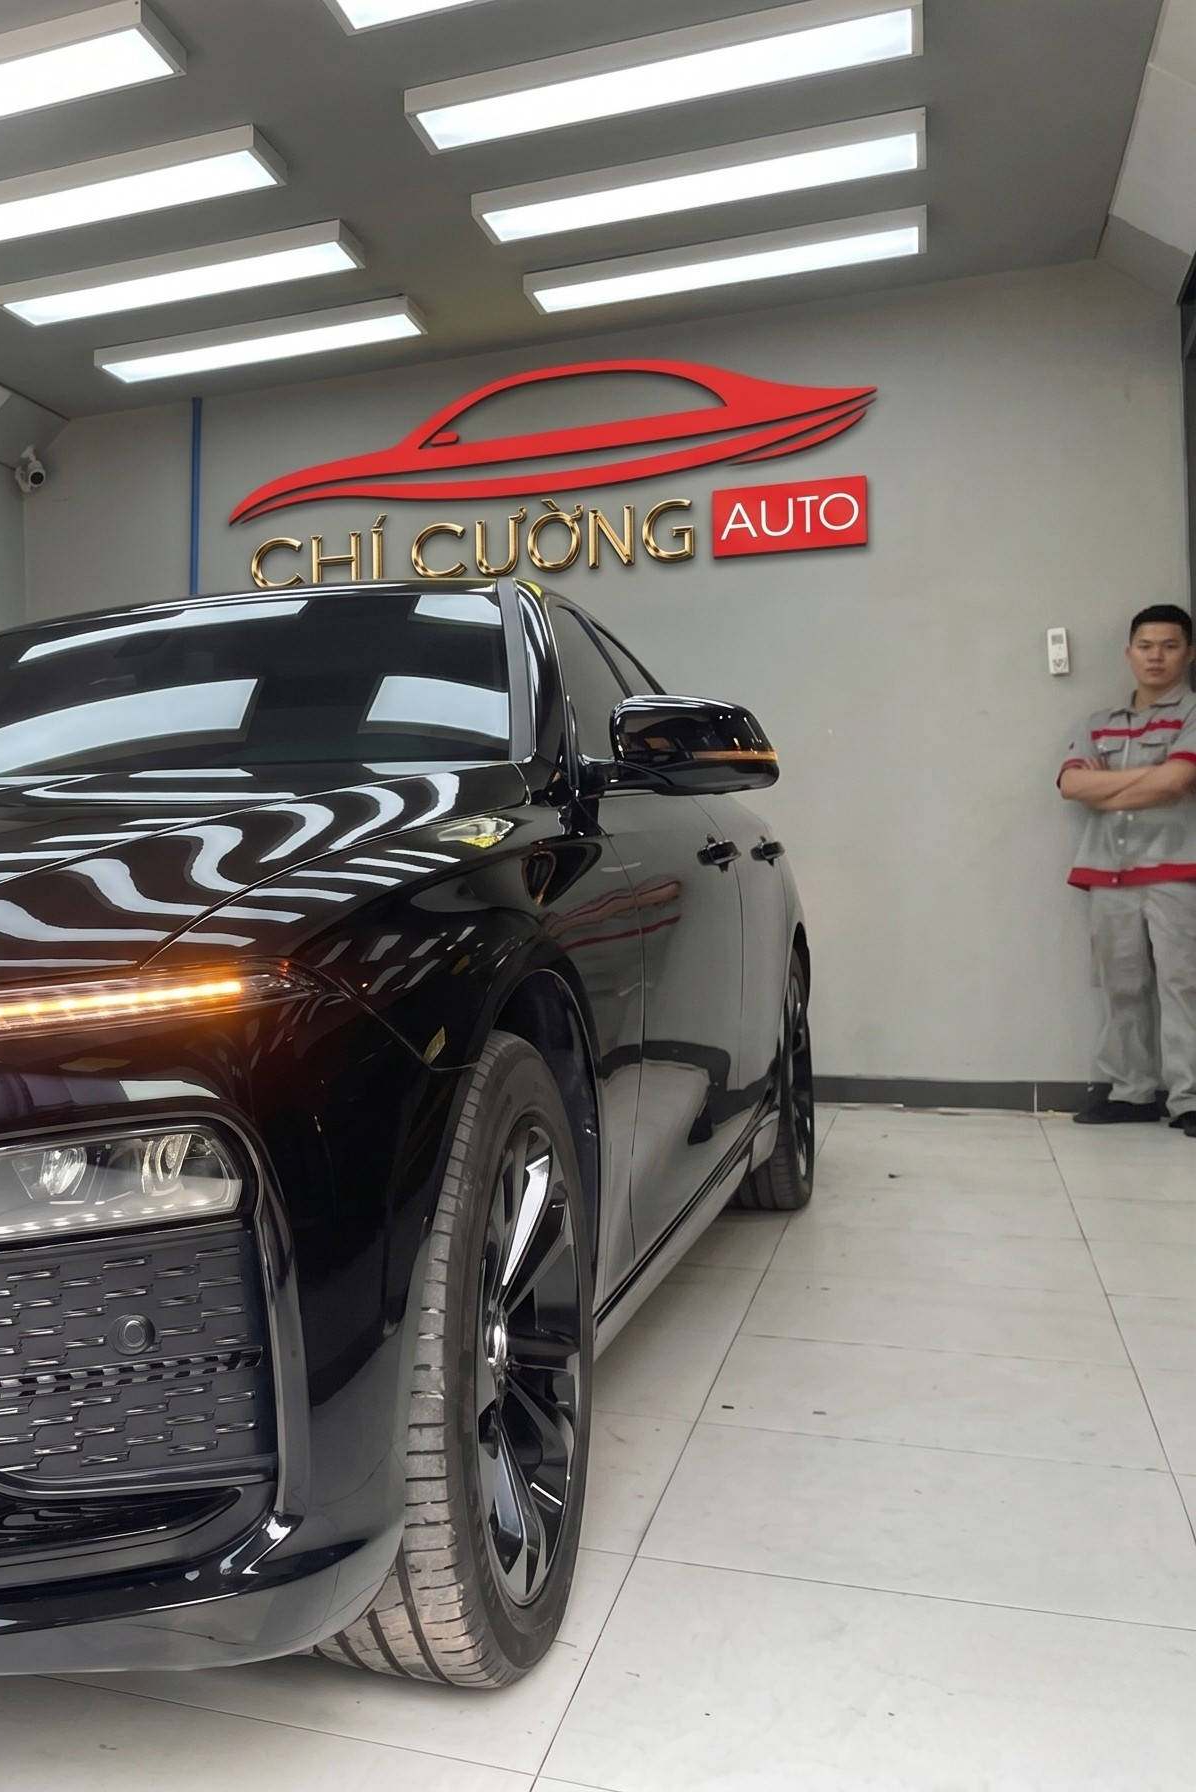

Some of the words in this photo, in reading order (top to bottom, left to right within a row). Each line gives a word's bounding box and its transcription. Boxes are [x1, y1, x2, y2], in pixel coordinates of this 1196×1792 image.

[251, 513, 388, 588] CHÍ
[411, 498, 695, 578] CƯỜNG
[720, 493, 859, 540] AUTO
